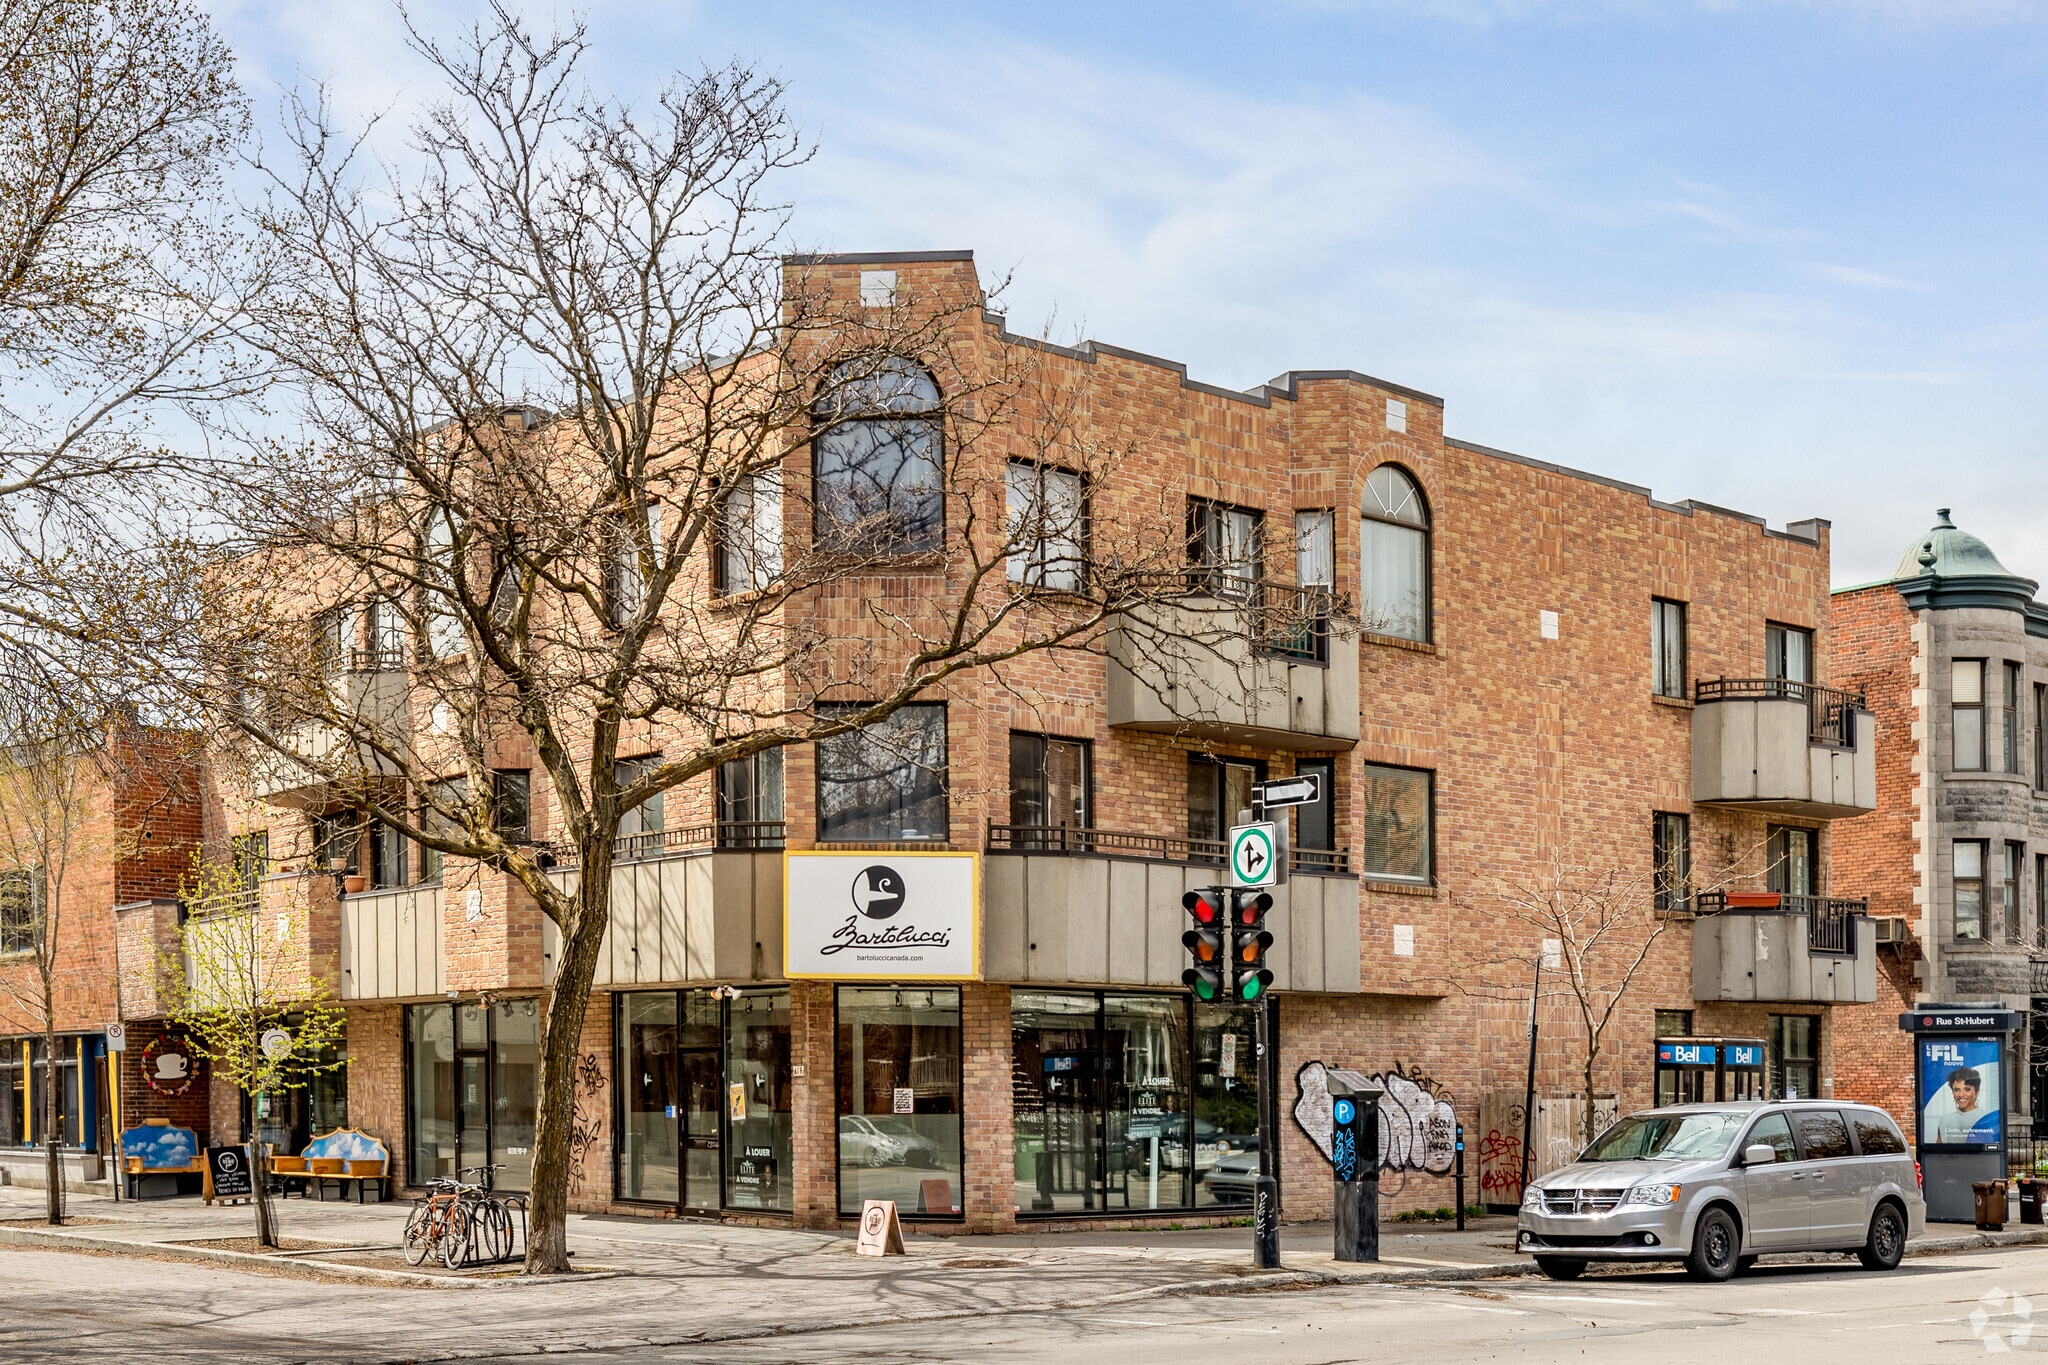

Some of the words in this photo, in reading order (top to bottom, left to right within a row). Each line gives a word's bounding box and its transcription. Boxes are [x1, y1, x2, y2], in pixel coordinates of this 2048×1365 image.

[820, 915, 951, 955] Bartolucci
[856, 954, 924, 962] bartoluccicanada.com
[1936, 1017, 1952, 1026] Rue
[1954, 1017, 1995, 1026] St-Hubert
[1675, 1045, 1700, 1062] Bell
[1735, 1046, 1752, 1064] Bell
[745, 1145, 751, 1156] À
[751, 1147, 771, 1157] LOUER
[740, 1176, 760, 1184] VENDRE
